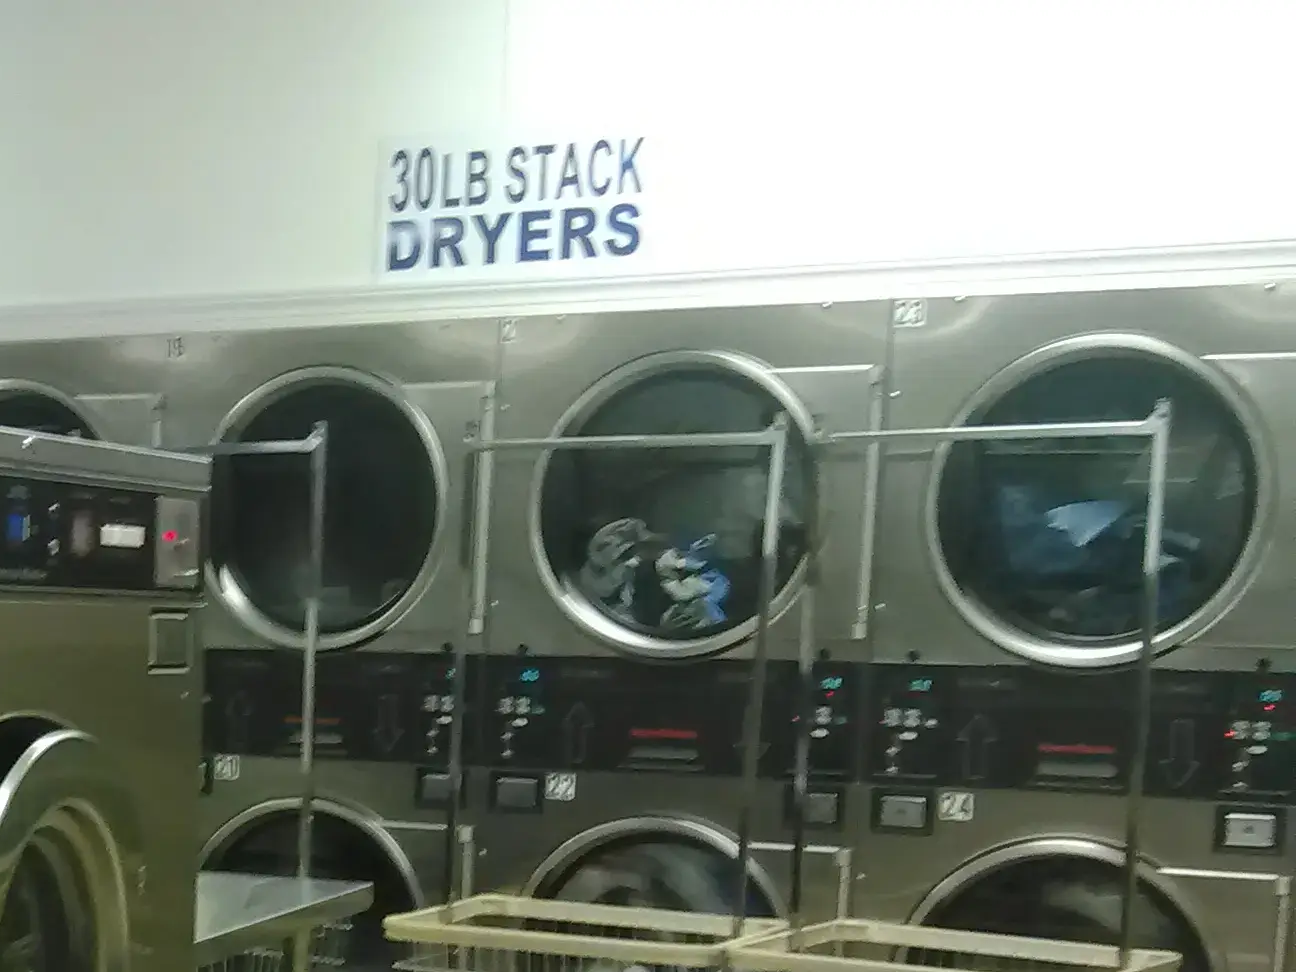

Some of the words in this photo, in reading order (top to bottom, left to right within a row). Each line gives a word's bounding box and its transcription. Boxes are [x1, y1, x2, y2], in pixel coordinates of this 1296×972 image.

[388, 146, 490, 212] 30LB
[504, 136, 645, 204] STACK
[386, 202, 641, 272] DRYERS
